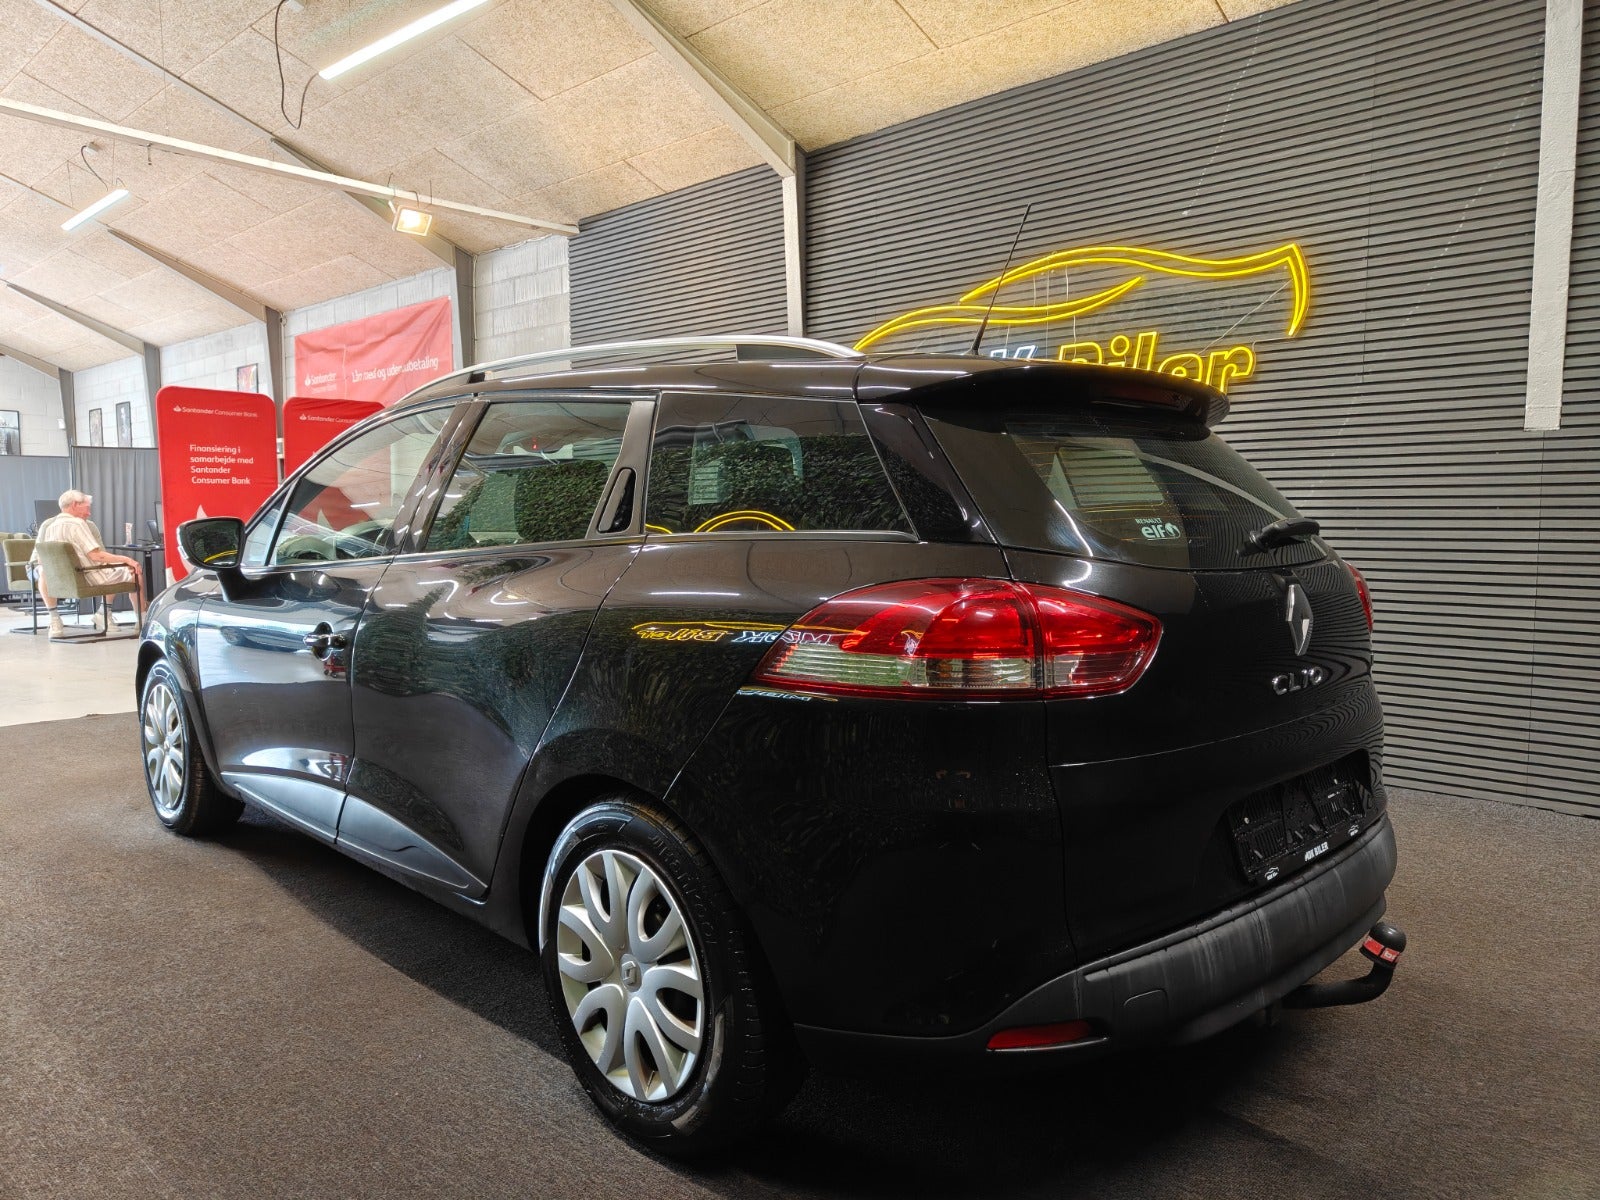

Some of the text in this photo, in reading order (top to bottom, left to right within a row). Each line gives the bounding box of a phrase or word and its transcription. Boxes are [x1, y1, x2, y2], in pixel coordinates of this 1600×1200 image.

[190, 444, 236, 454] Finansiering
[190, 456, 254, 464] samarbejde med
[190, 465, 231, 474] Santander
[191, 475, 251, 485] Consumer Bank
[1141, 524, 1166, 538] elf
[1271, 666, 1324, 695] CLIO
